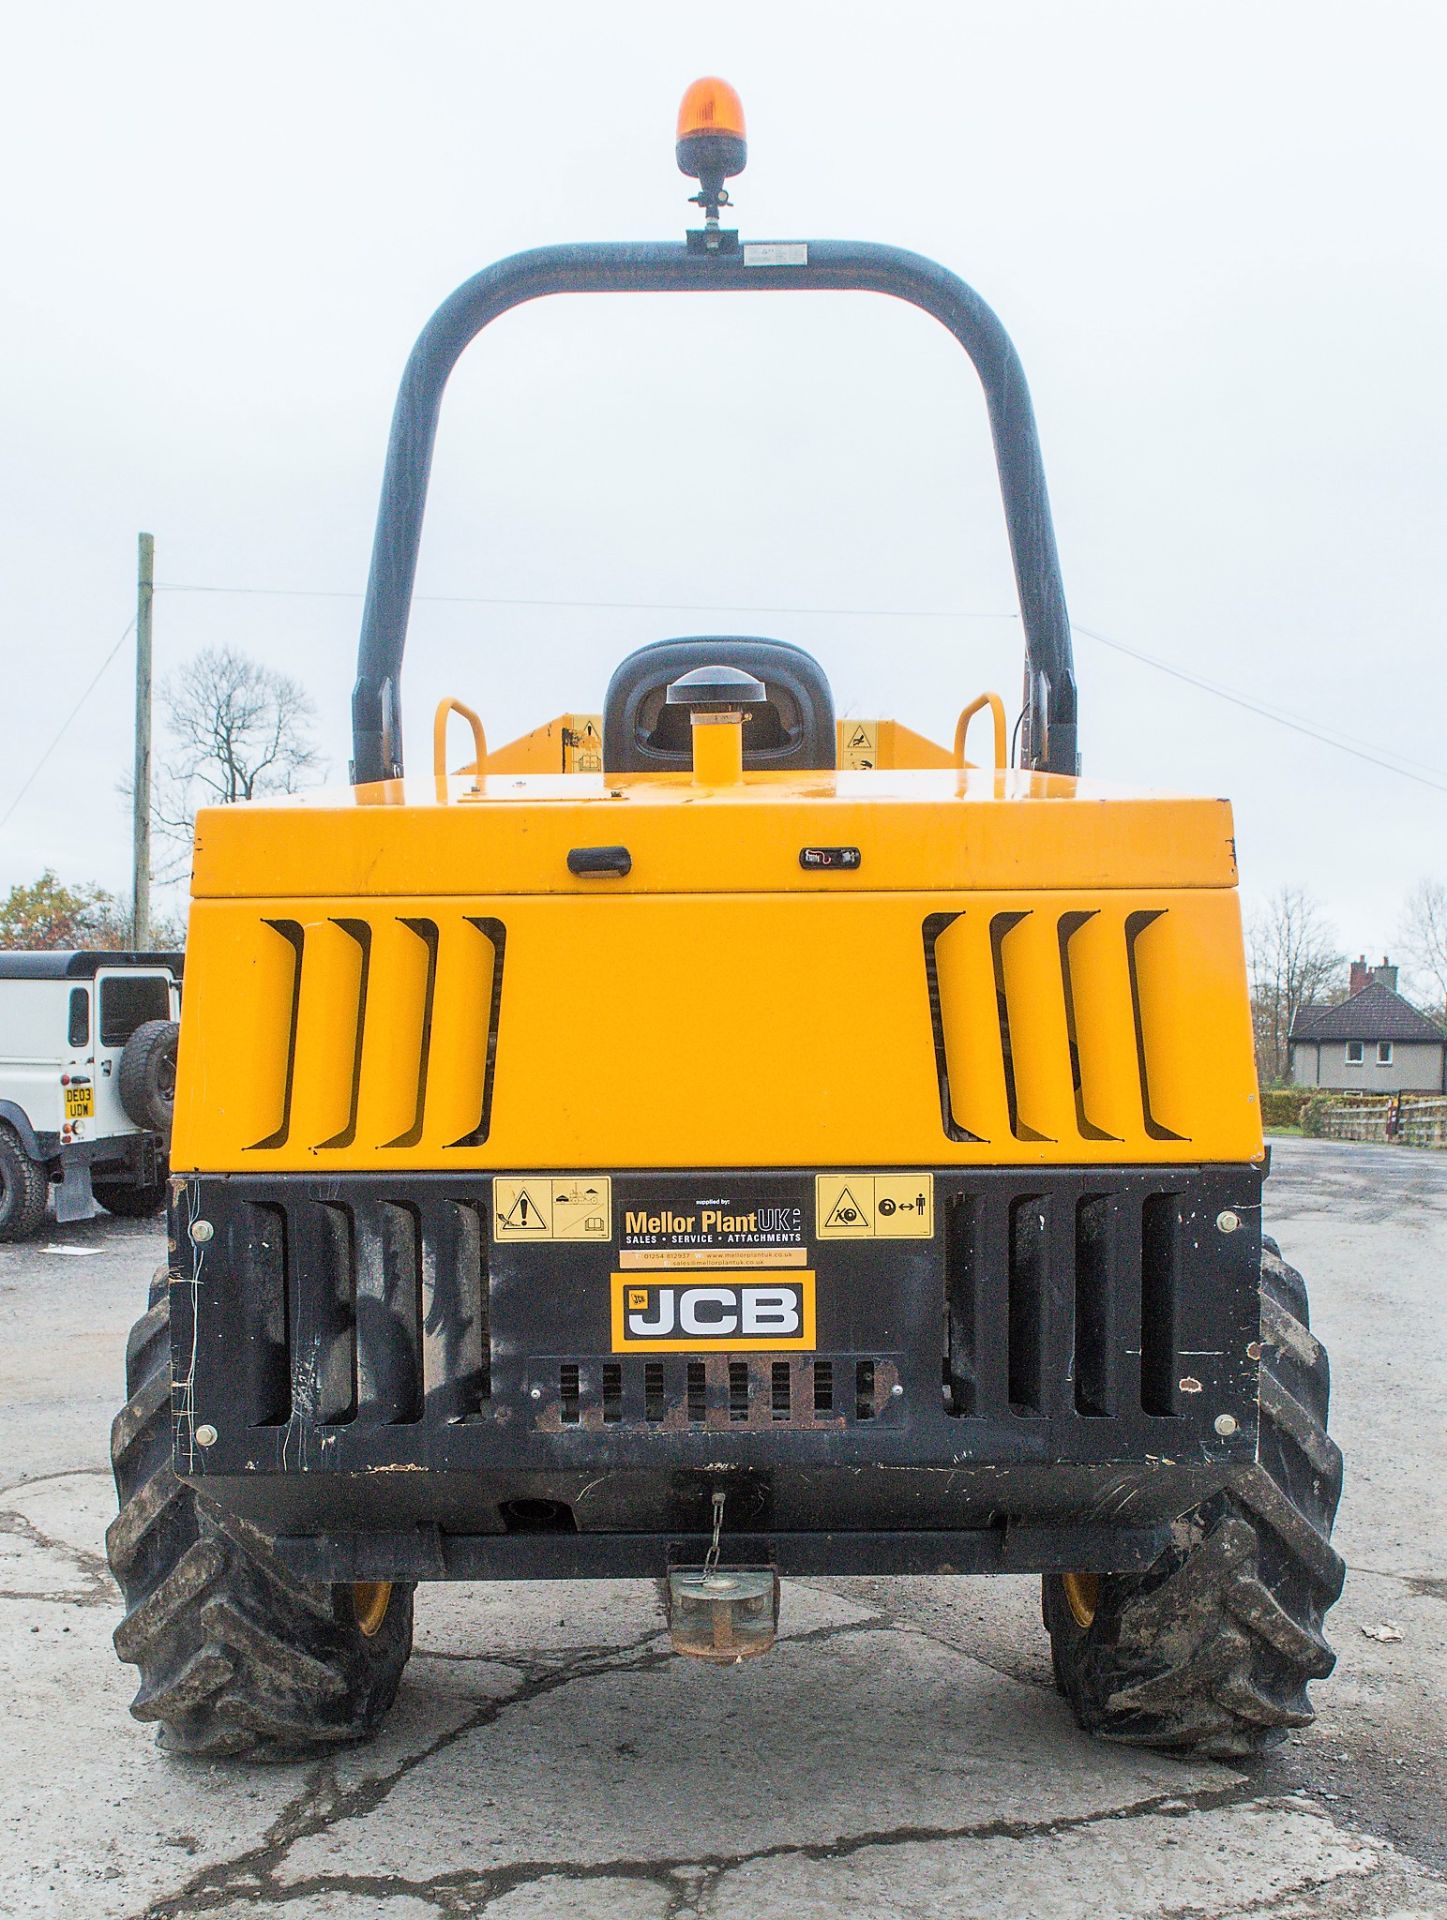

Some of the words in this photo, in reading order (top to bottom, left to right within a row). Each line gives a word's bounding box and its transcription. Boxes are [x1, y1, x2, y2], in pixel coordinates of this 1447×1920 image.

[66, 1088, 91, 1102] DE03
[625, 1211, 695, 1233] Mellor
[792, 1208, 801, 1231] LTD
[626, 1235, 657, 1244] SALES
[671, 1234, 713, 1243] SERVICE
[727, 1233, 801, 1243] ATTACHMENTS
[706, 1251, 792, 1259] www.mellorplantuk.co.uk
[628, 1288, 799, 1336] JCB
